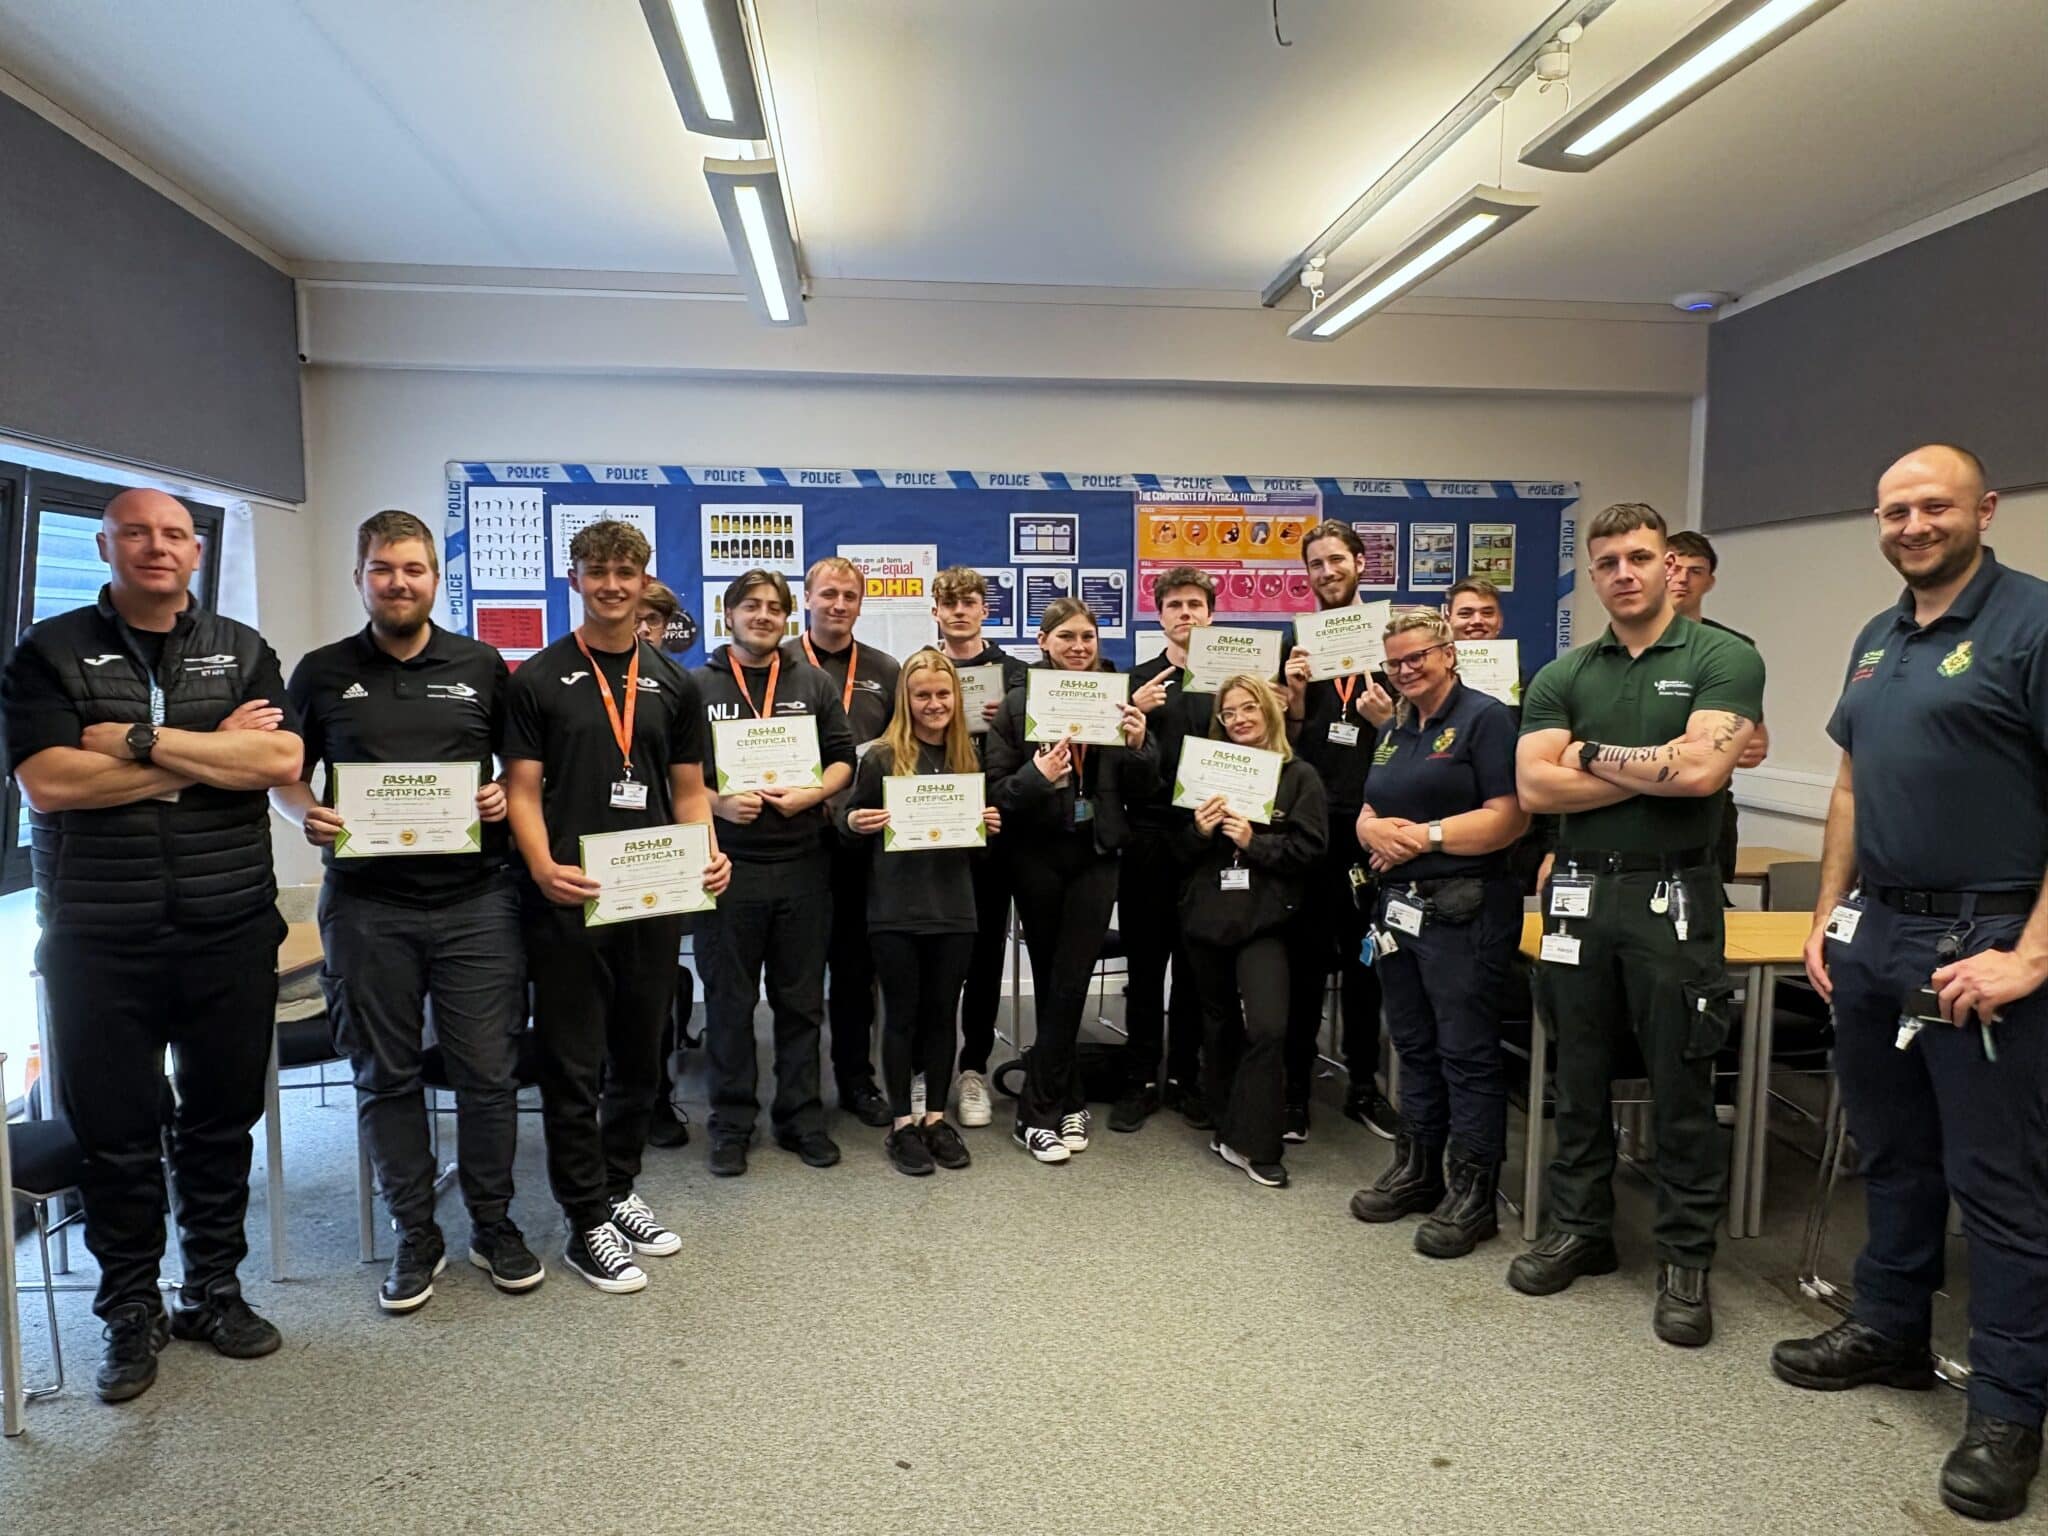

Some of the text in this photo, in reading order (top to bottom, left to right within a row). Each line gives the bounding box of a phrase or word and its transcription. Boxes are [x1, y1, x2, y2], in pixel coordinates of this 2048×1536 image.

[506, 466, 550, 480] POLICE
[606, 468, 648, 481] POLICE
[704, 470, 745, 483] POLICE
[800, 471, 841, 484] POLICE
[895, 472, 936, 486] POLICE
[989, 474, 1031, 487] POLICE
[1082, 475, 1123, 488] POLICE
[1173, 477, 1213, 489] POLICE
[1264, 479, 1303, 491] POLICE
[1353, 481, 1392, 493] POLICE
[1440, 482, 1480, 495] POLICE
[1527, 483, 1566, 496] POLICE
[448, 480, 461, 518] POLIC
[1561, 519, 1575, 559] POLICE
[882, 561, 913, 577] equal
[866, 578, 924, 597] DHR
[451, 573, 463, 616] POLICE
[1558, 610, 1571, 648] POLICE
[1048, 690, 1108, 699] CERTIFICATE
[736, 736, 797, 747] CERTIFICATE
[1200, 758, 1260, 776] CERTIFICATE
[366, 788, 451, 797] CERTIFICATE
[905, 794, 965, 804] CERTIFICATE
[610, 849, 686, 866] CERTIFICATE
